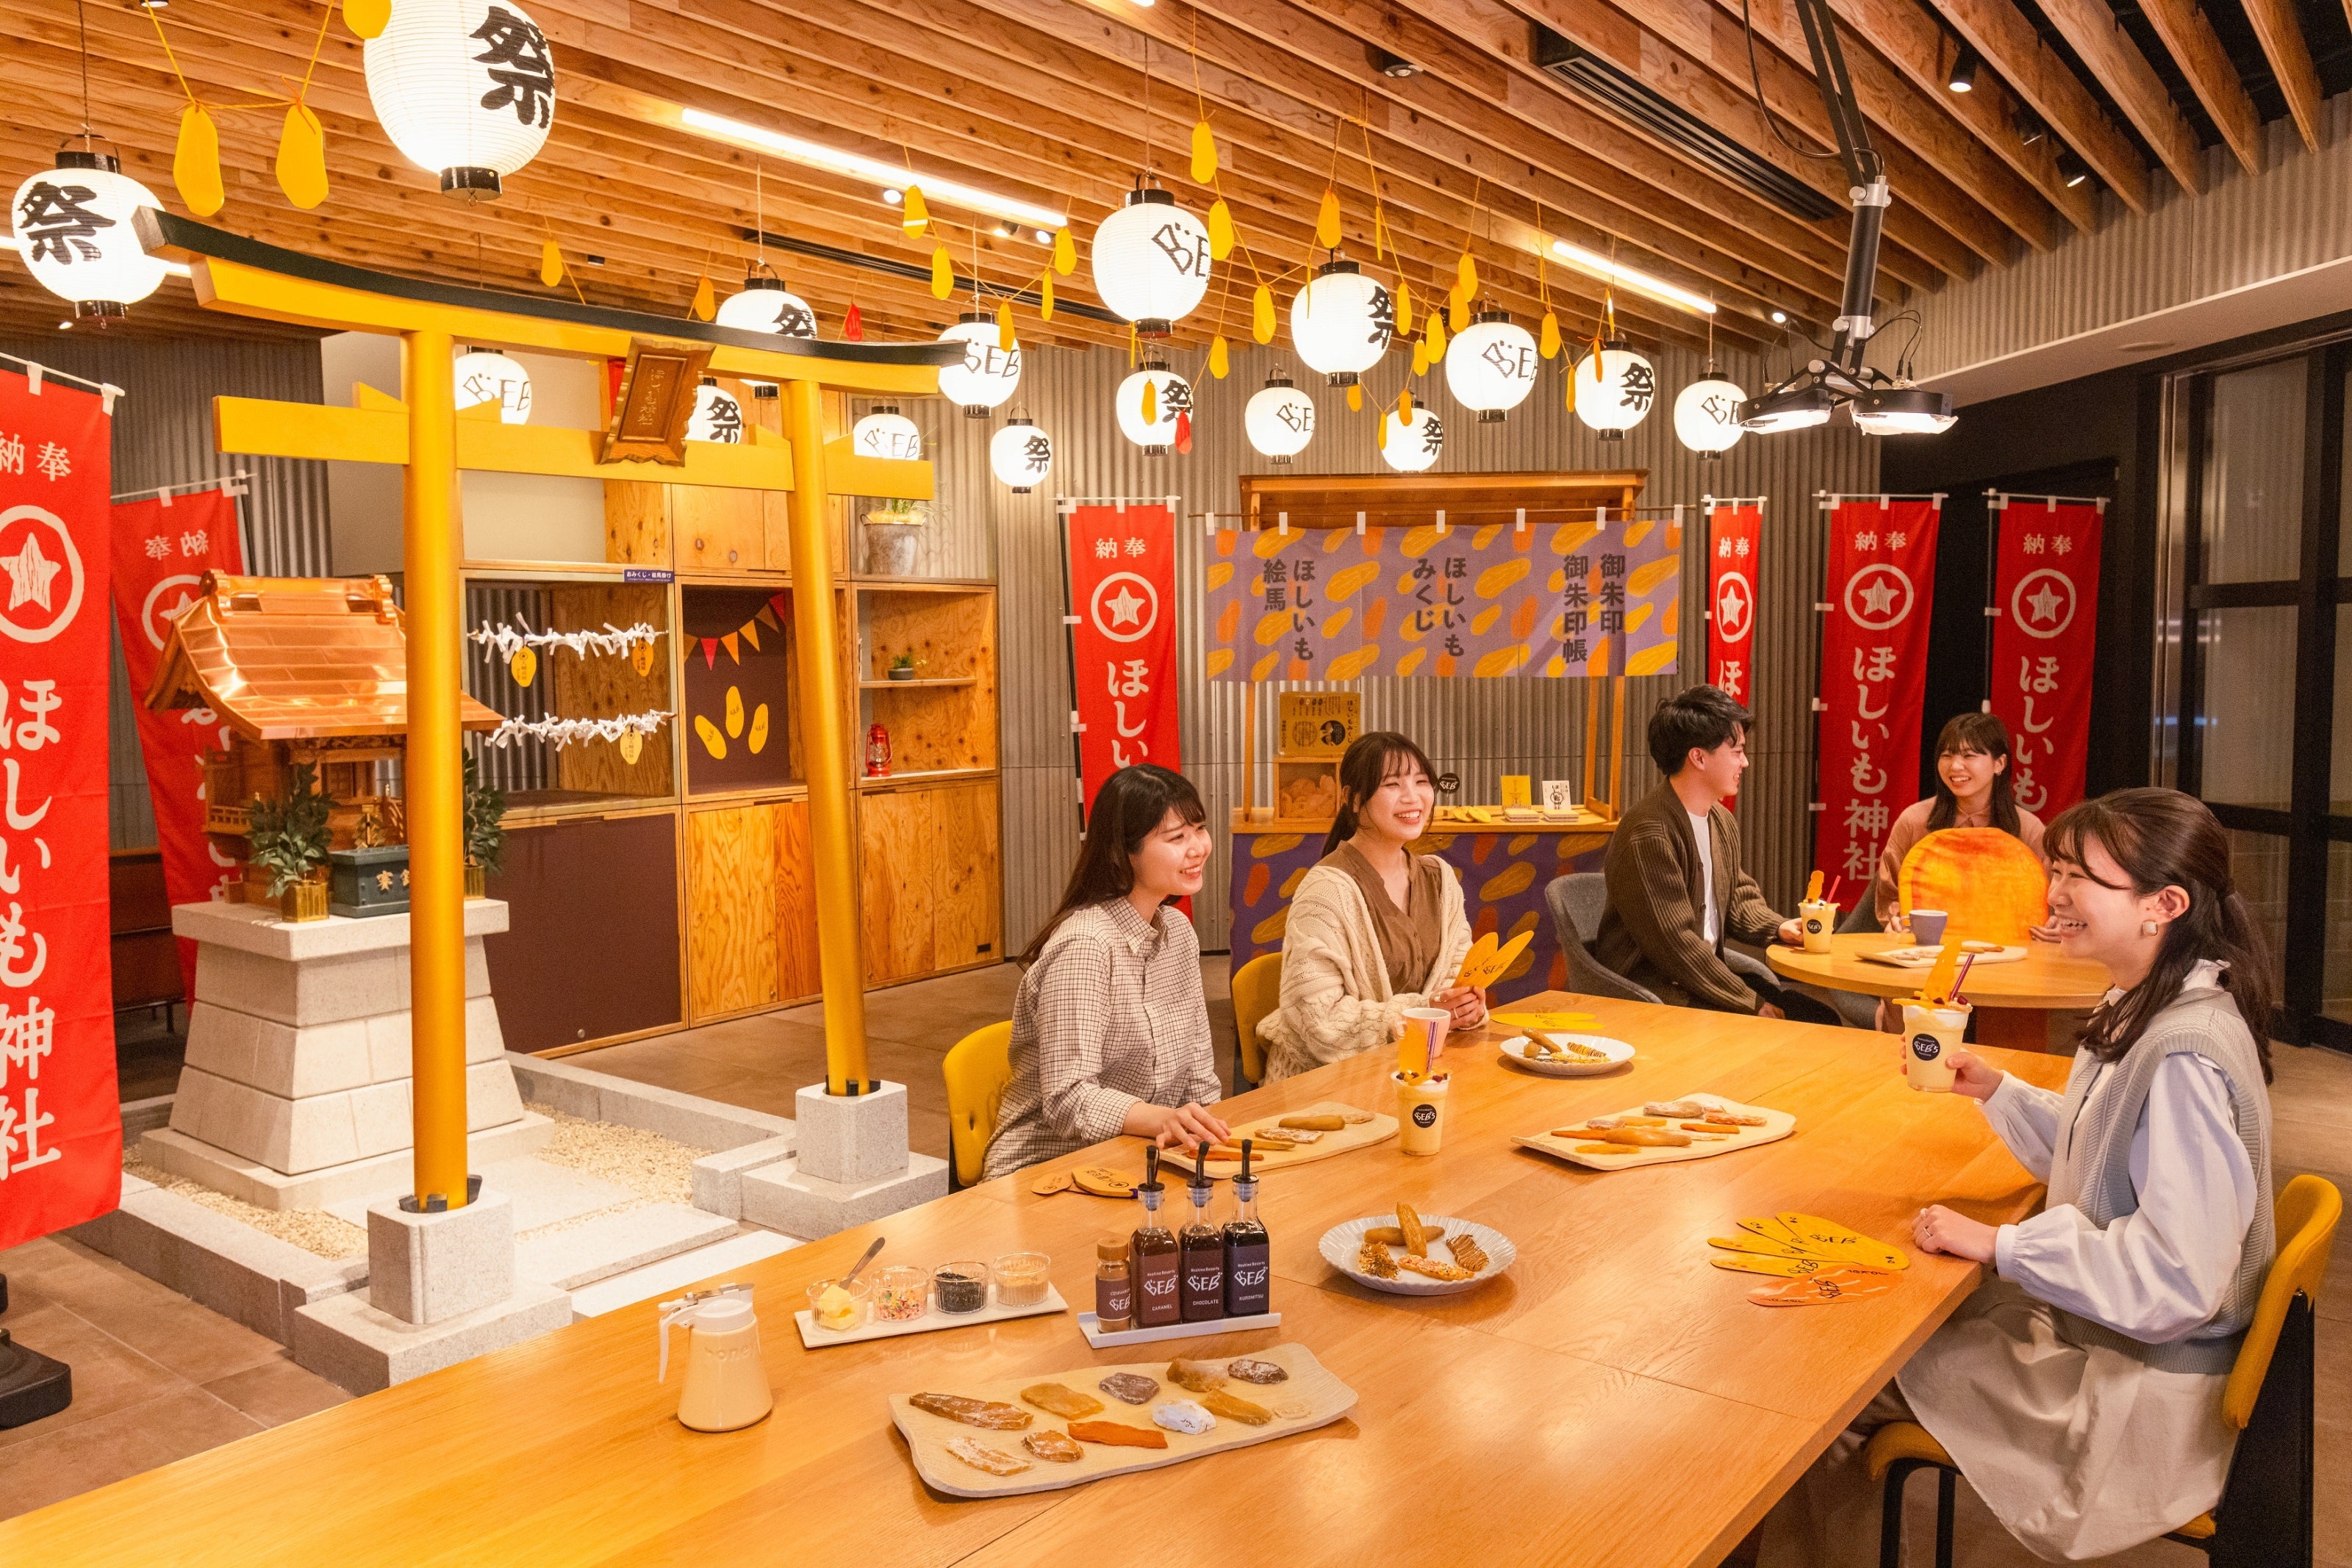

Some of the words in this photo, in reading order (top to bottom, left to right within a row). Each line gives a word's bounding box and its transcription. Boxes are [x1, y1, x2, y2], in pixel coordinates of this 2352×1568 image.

[469, 5, 556, 130] 祭
[19, 181, 115, 265] 祭
[1151, 222, 1211, 284] BE
[1482, 340, 1538, 381] BE
[1621, 362, 1655, 413] 祭
[706, 395, 742, 444] 祭
[1023, 435, 1051, 473] 祭
[1276, 403, 1315, 433] BE
[1263, 558, 1288, 611] 絵馬
[1293, 558, 1316, 661] ほしいも
[1412, 557, 1437, 632] みくじ
[1444, 556, 1467, 657] ほしいも
[1563, 555, 1589, 663] 御朱印帳
[1599, 553, 1626, 635] 御朱印
[1842, 647, 1897, 881] ほしいも神社
